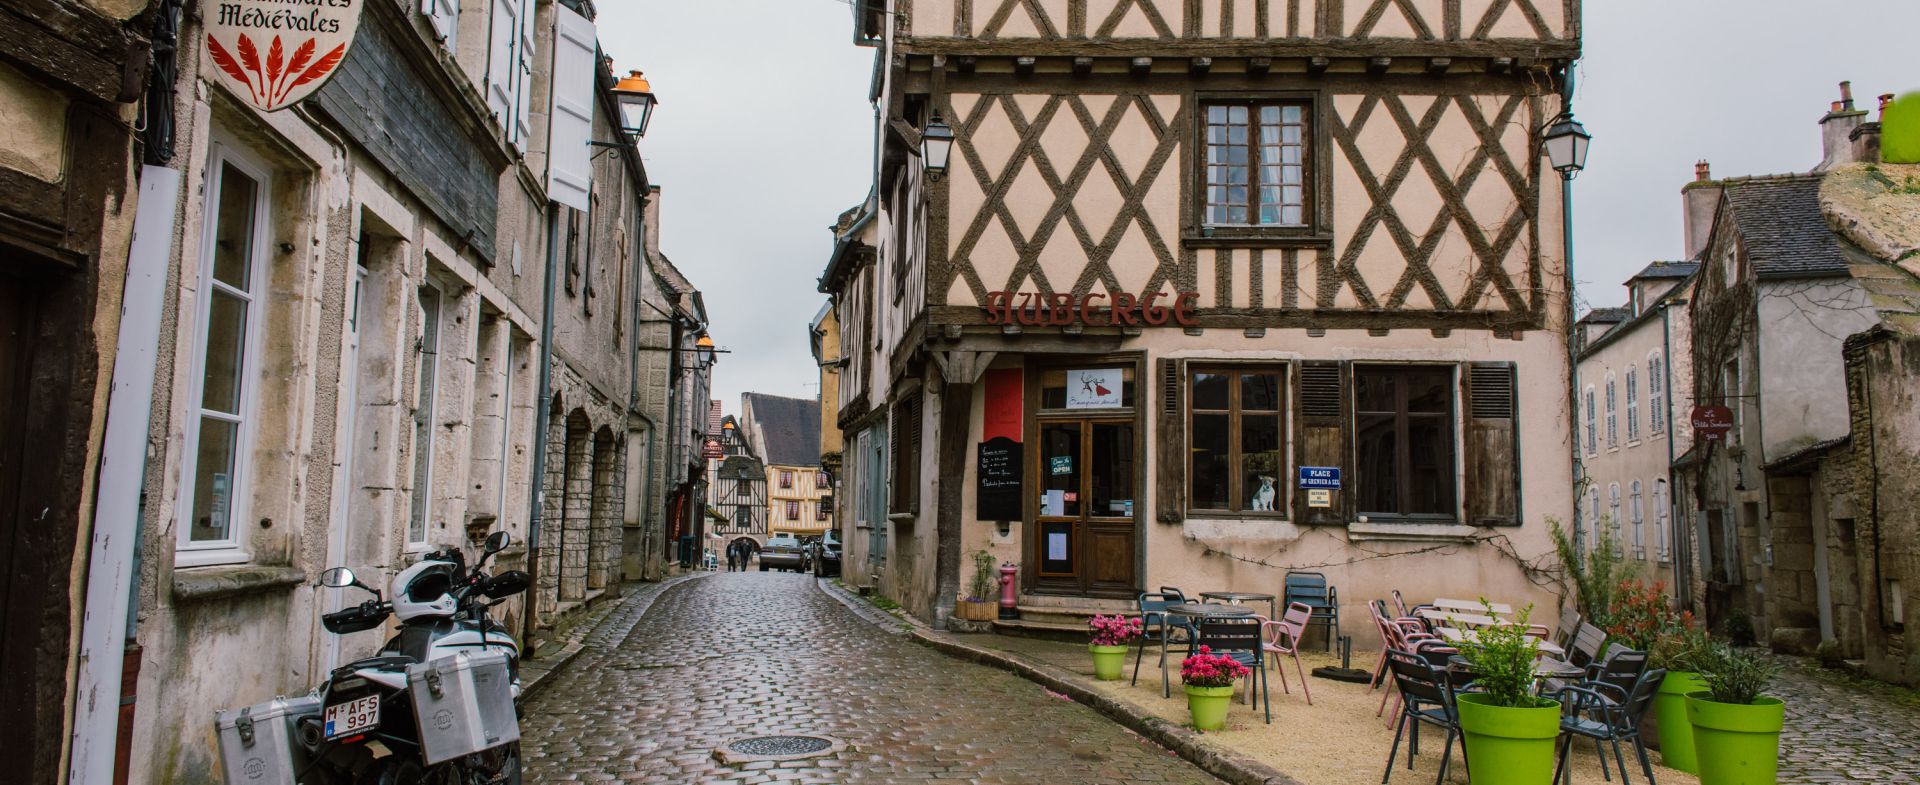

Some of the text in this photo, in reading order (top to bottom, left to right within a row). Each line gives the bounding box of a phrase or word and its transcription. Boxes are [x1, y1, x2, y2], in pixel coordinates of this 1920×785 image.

[218, 4, 340, 33] Médiévales
[986, 291, 1201, 327] AUBERGE
[348, 710, 377, 729] 997
